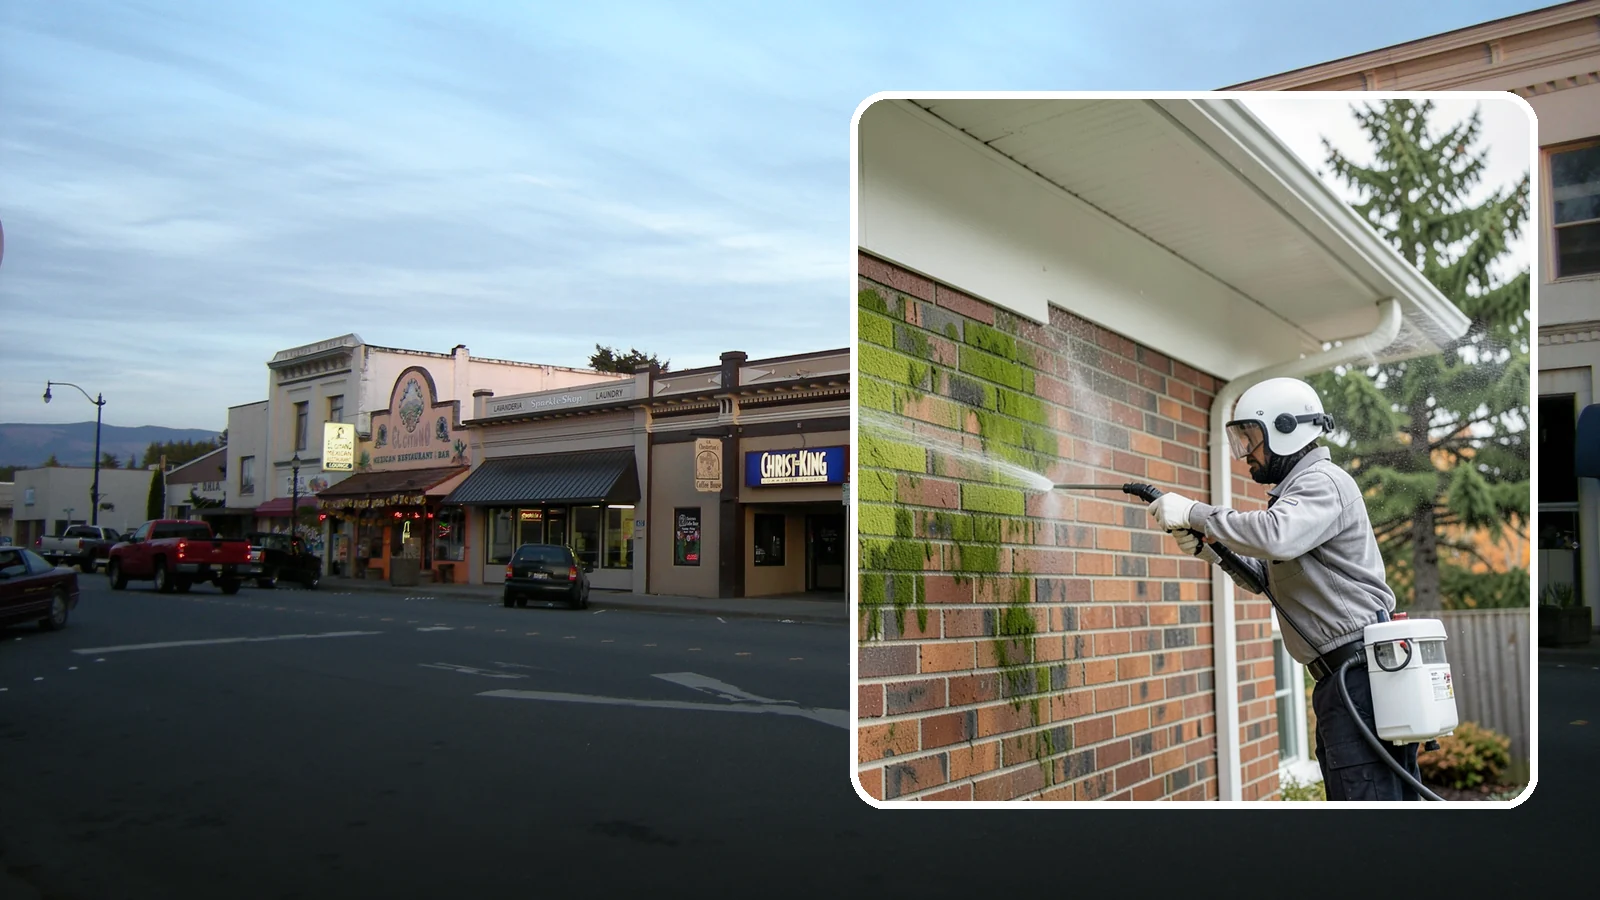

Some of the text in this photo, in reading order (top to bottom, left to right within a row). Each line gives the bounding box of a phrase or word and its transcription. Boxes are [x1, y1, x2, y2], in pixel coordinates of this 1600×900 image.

[531, 394, 583, 408] Sparkle Shop
[595, 389, 623, 399] LAUNDRY
[494, 402, 523, 412] LAVANDERIA
[373, 450, 450, 464] MEXICAN RESTAURANT BAR
[761, 450, 827, 478] CHRIST KING
